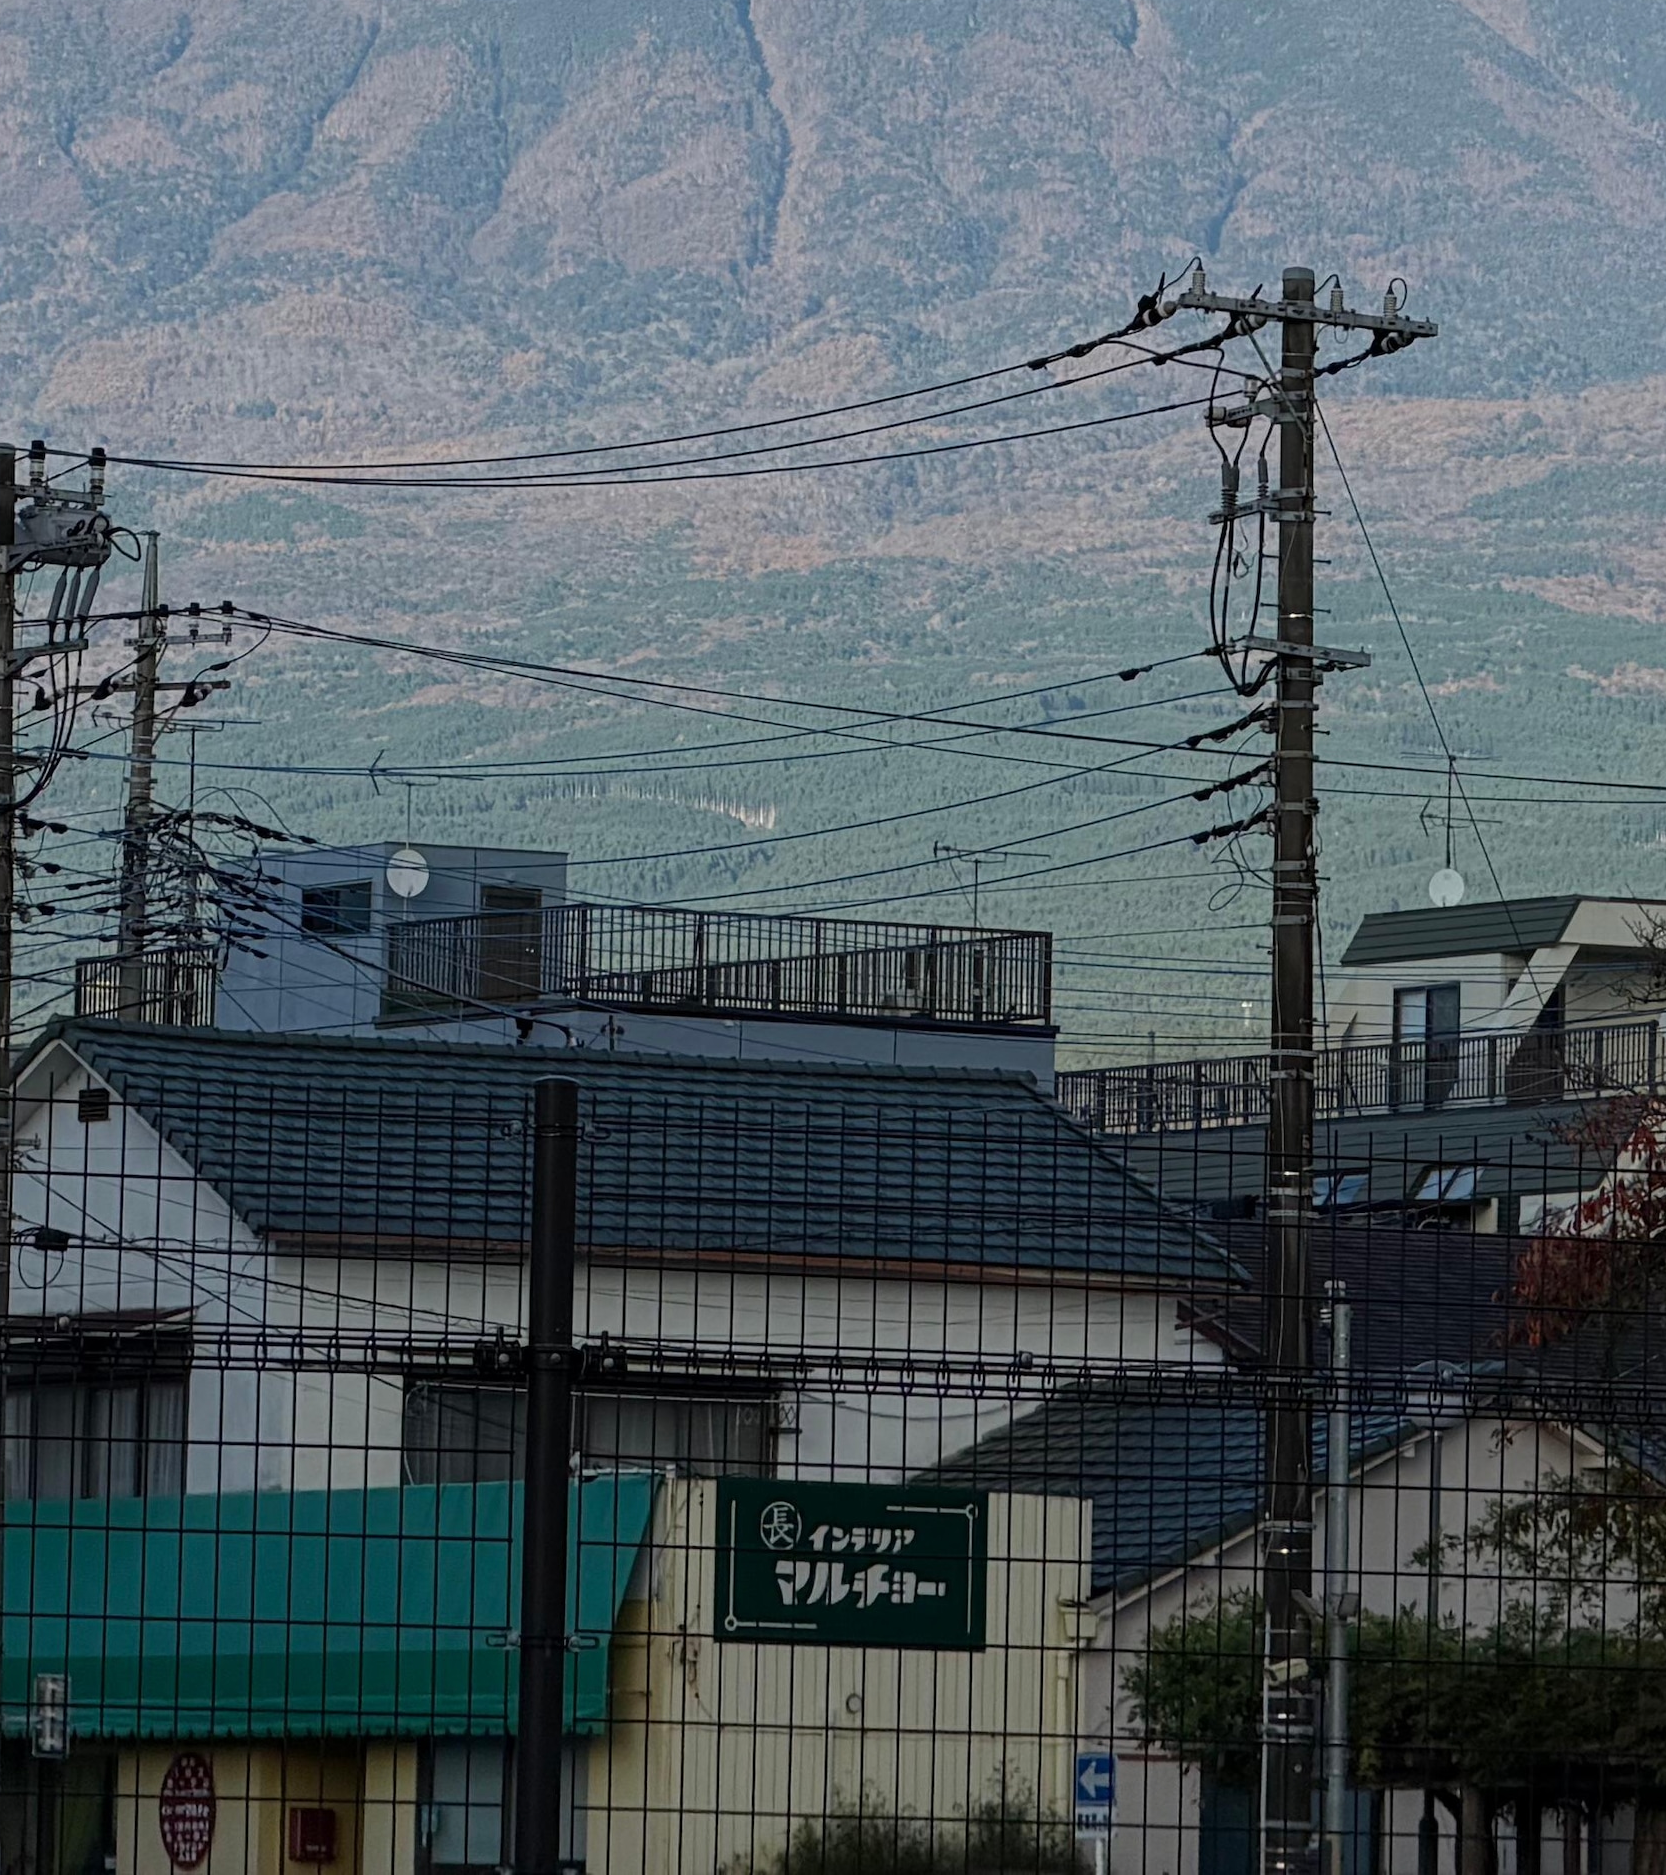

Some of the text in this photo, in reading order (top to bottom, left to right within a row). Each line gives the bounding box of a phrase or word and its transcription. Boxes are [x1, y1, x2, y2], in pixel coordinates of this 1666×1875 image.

[761, 1503, 916, 1555] 長 インテリア
[774, 1559, 947, 1609] マルチョー
